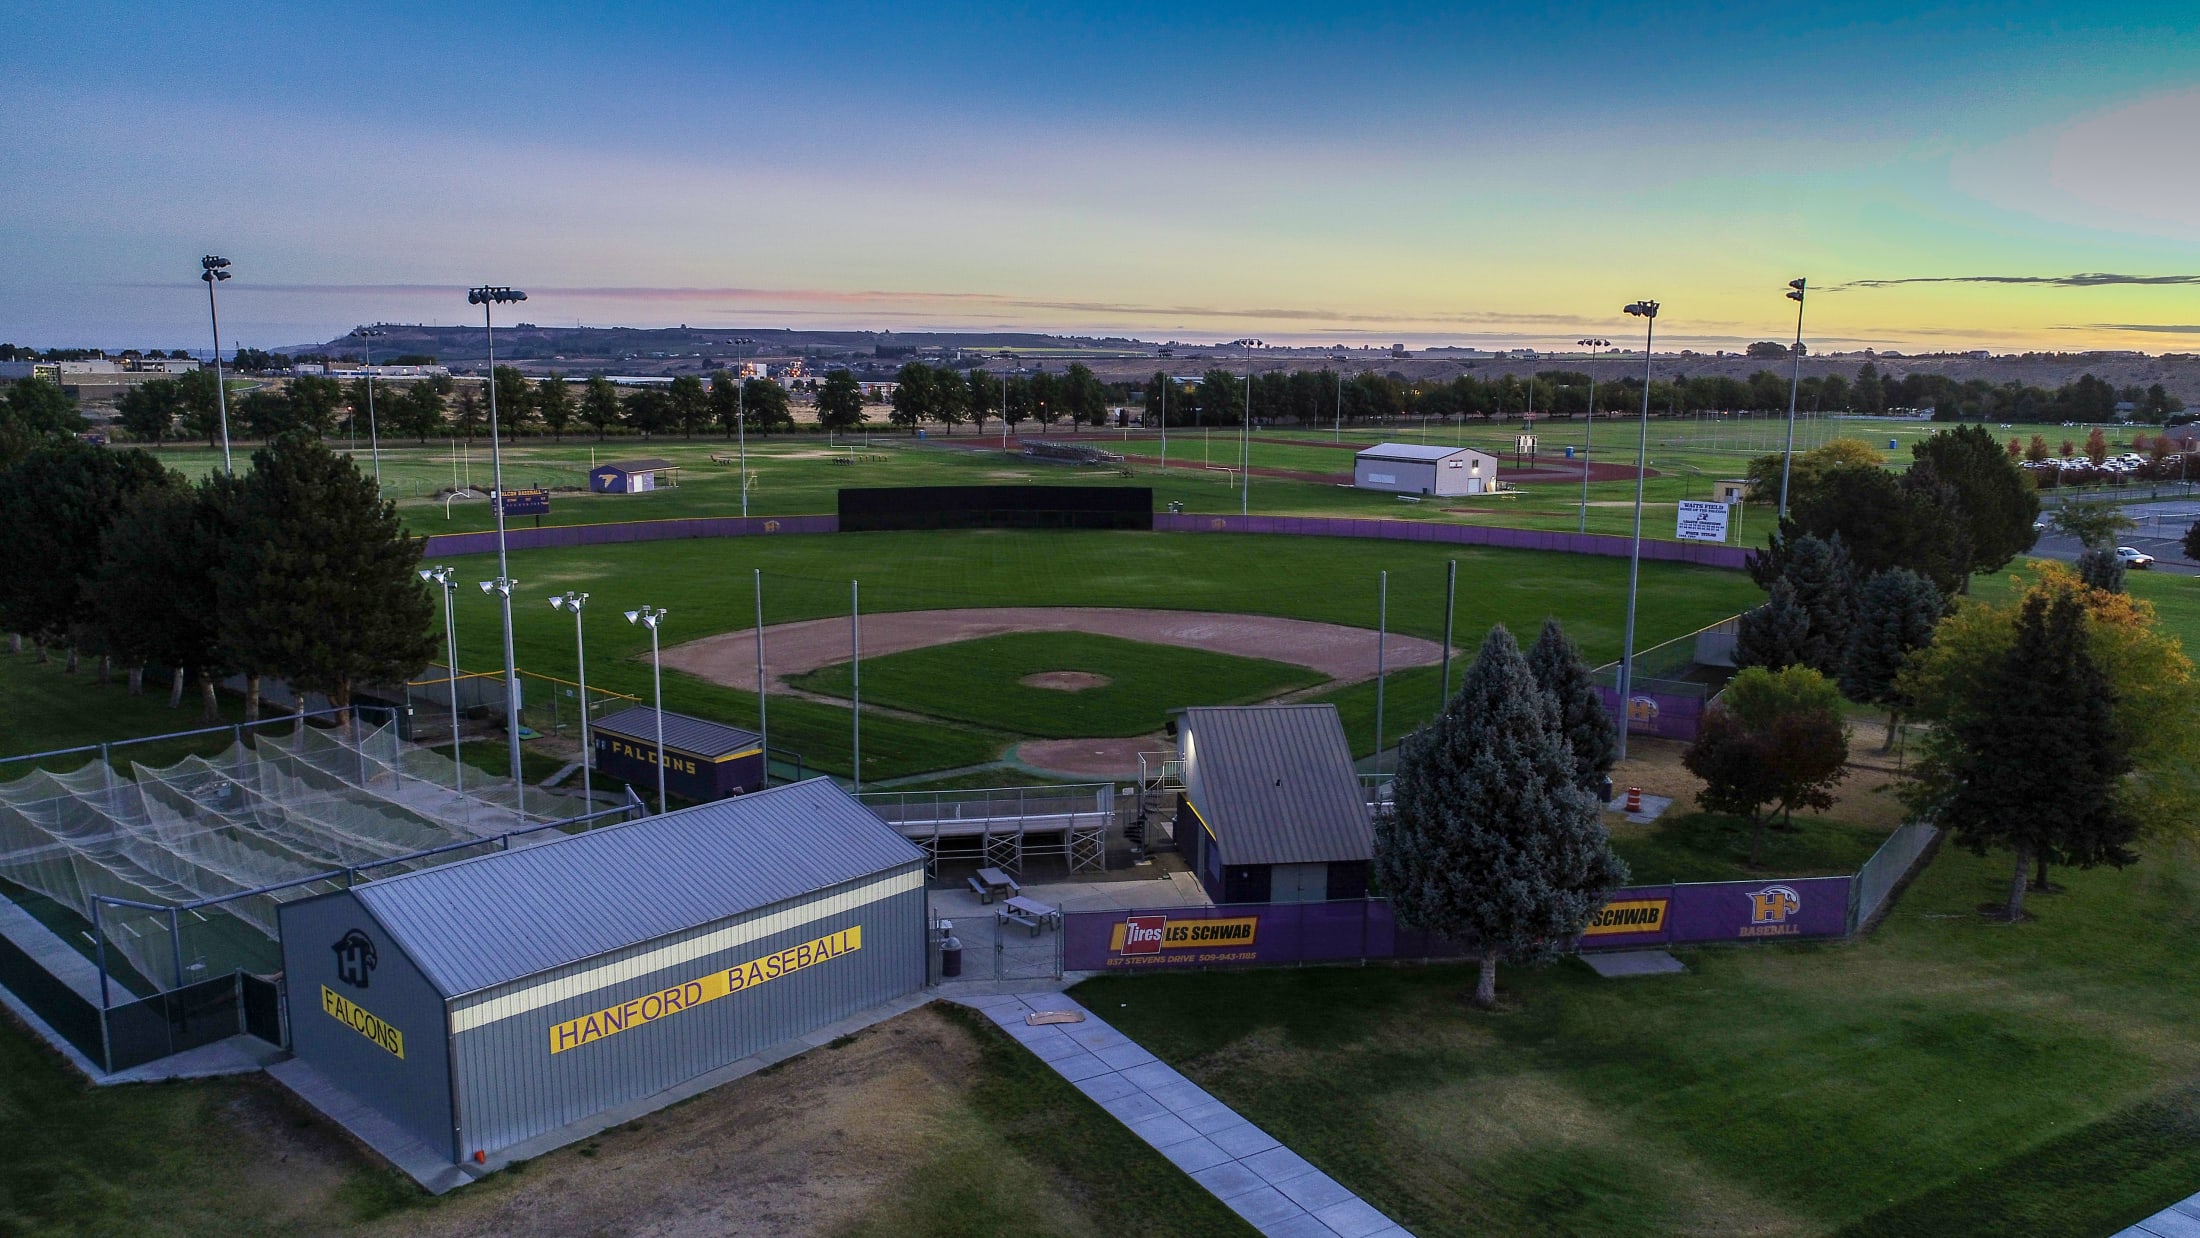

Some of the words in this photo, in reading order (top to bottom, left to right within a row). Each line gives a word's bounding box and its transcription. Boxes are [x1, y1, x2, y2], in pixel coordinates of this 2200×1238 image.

[612, 741, 696, 775] FALCONS
[1592, 908, 1660, 926] SCHWAB
[1127, 922, 1162, 944] Tires
[1165, 926, 1188, 942] LES
[1191, 924, 1251, 940] SCHWAB
[1738, 924, 1800, 936] BASEBALL
[1124, 956, 1166, 965] STEVENS
[1168, 954, 1195, 962] DRIVE
[558, 982, 702, 1050] HANFORD
[728, 932, 855, 992] BASEBALL
[325, 989, 398, 1054] FALCONS
